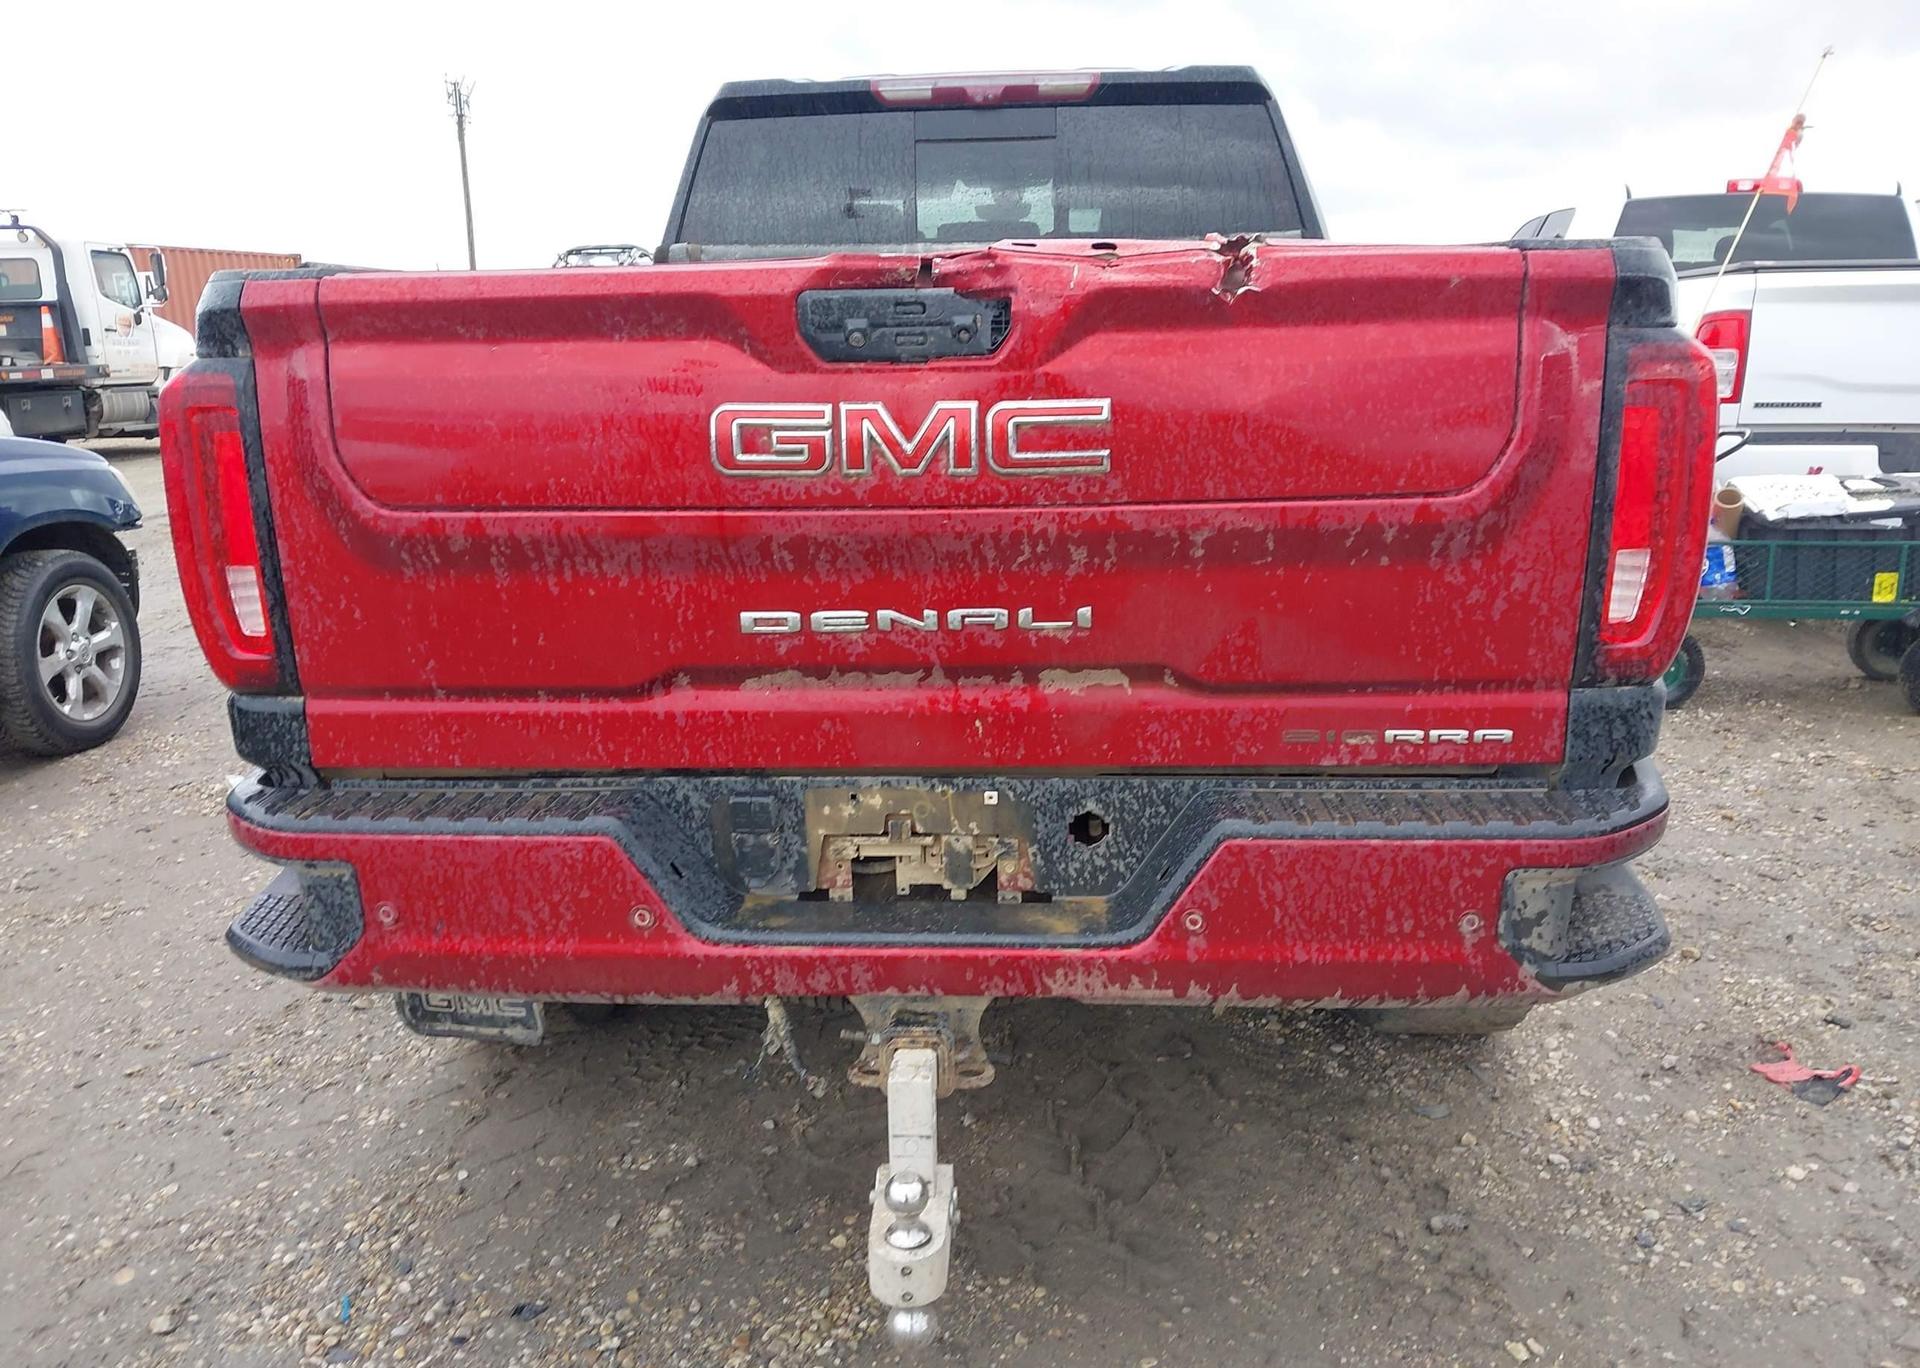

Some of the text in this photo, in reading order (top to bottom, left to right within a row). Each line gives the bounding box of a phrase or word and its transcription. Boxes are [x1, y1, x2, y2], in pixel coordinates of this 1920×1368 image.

[709, 397, 1112, 477] GMC
[738, 605, 1093, 635] DENALI
[420, 991, 527, 1018] GMC
